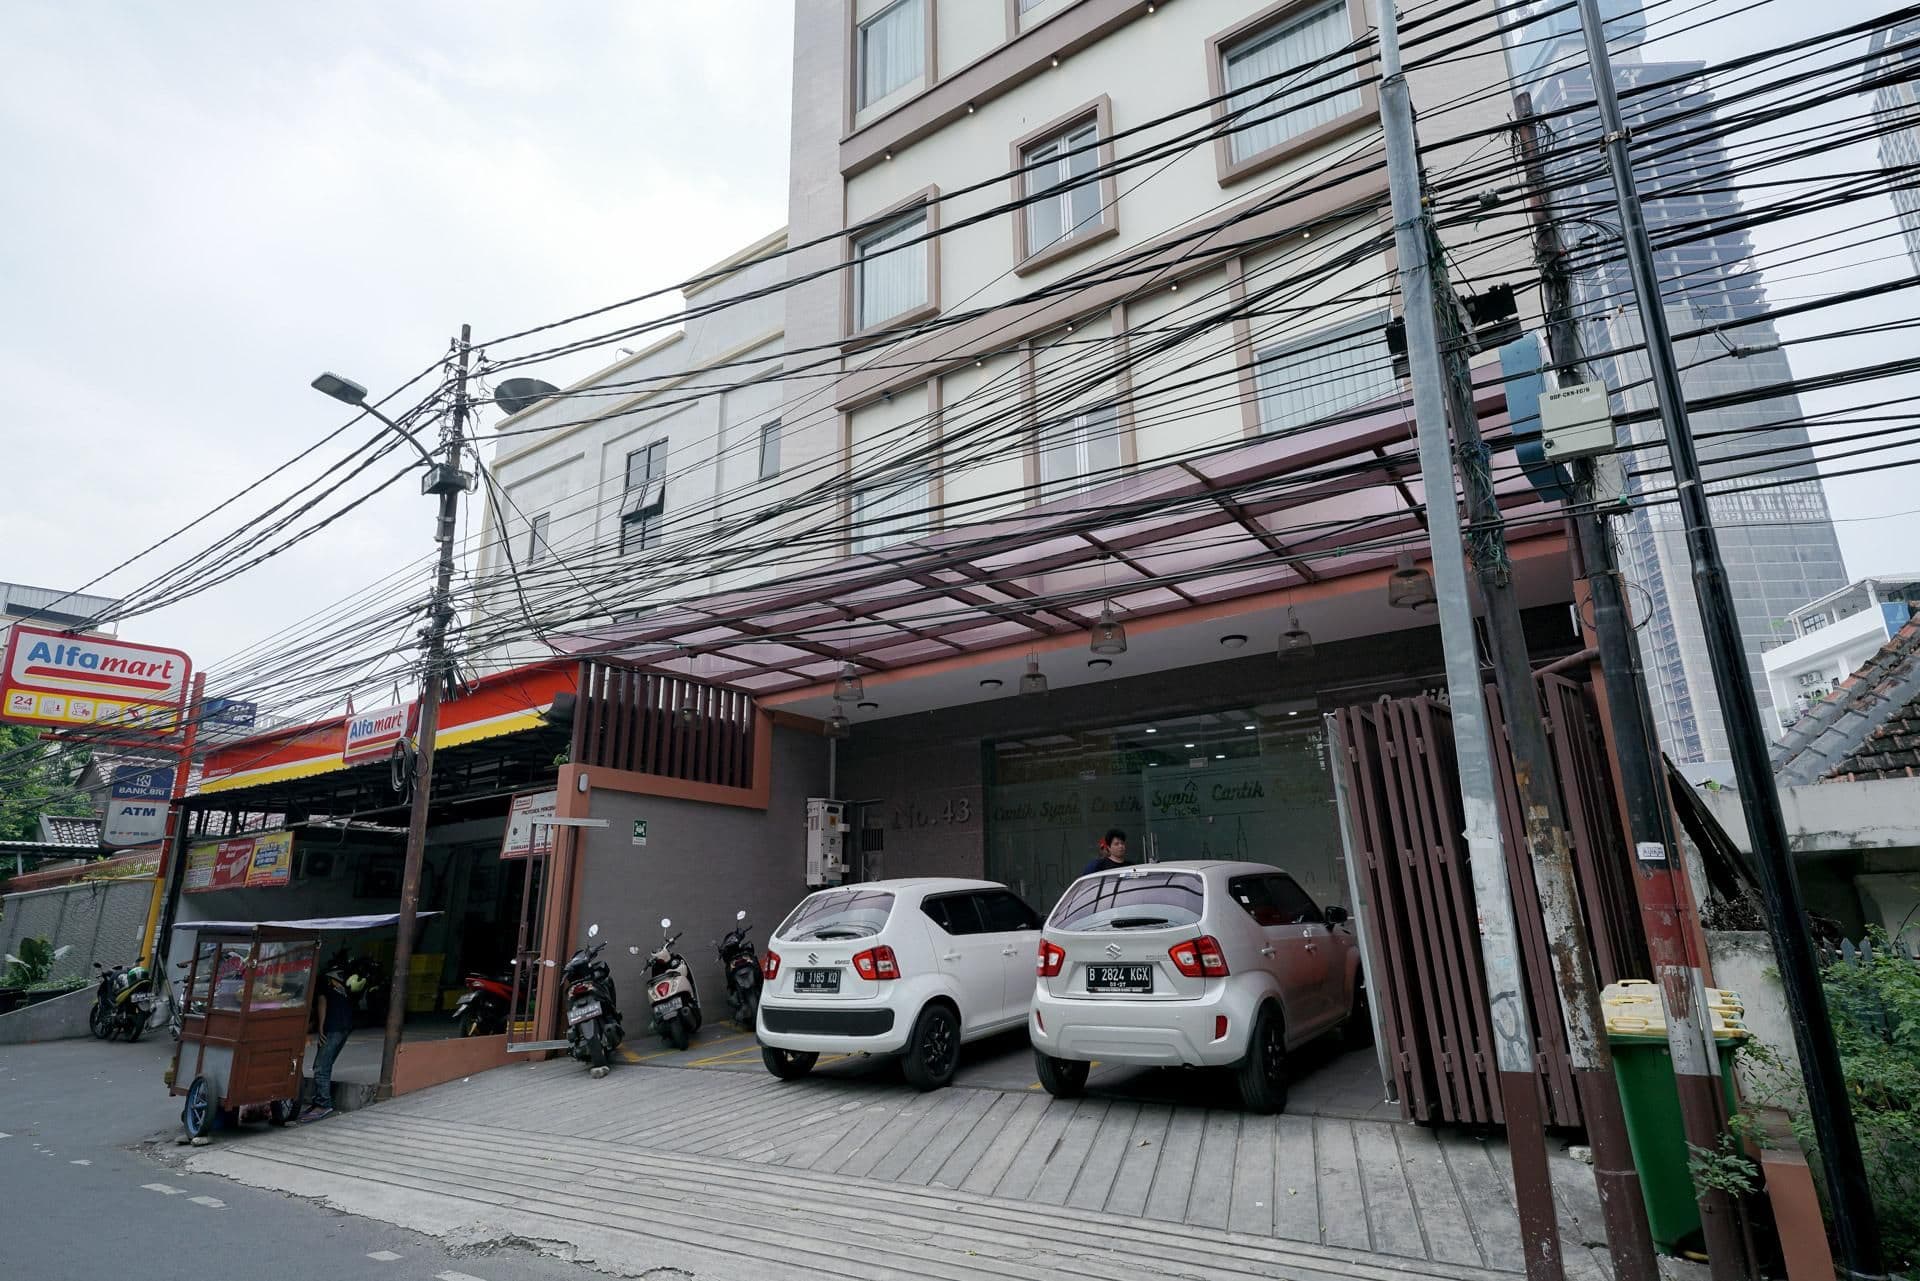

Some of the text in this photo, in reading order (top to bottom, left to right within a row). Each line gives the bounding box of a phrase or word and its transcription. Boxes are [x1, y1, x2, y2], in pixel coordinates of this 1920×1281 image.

[27, 641, 175, 679] Alfamart
[14, 695, 32, 706] 24
[350, 710, 403, 738] Alfamart
[119, 787, 165, 796] BANK BRI
[1211, 780, 1265, 801] Cantik
[120, 806, 156, 816] ATM
[943, 797, 971, 824] 43
[1089, 967, 1149, 981] B 2824 KGX
